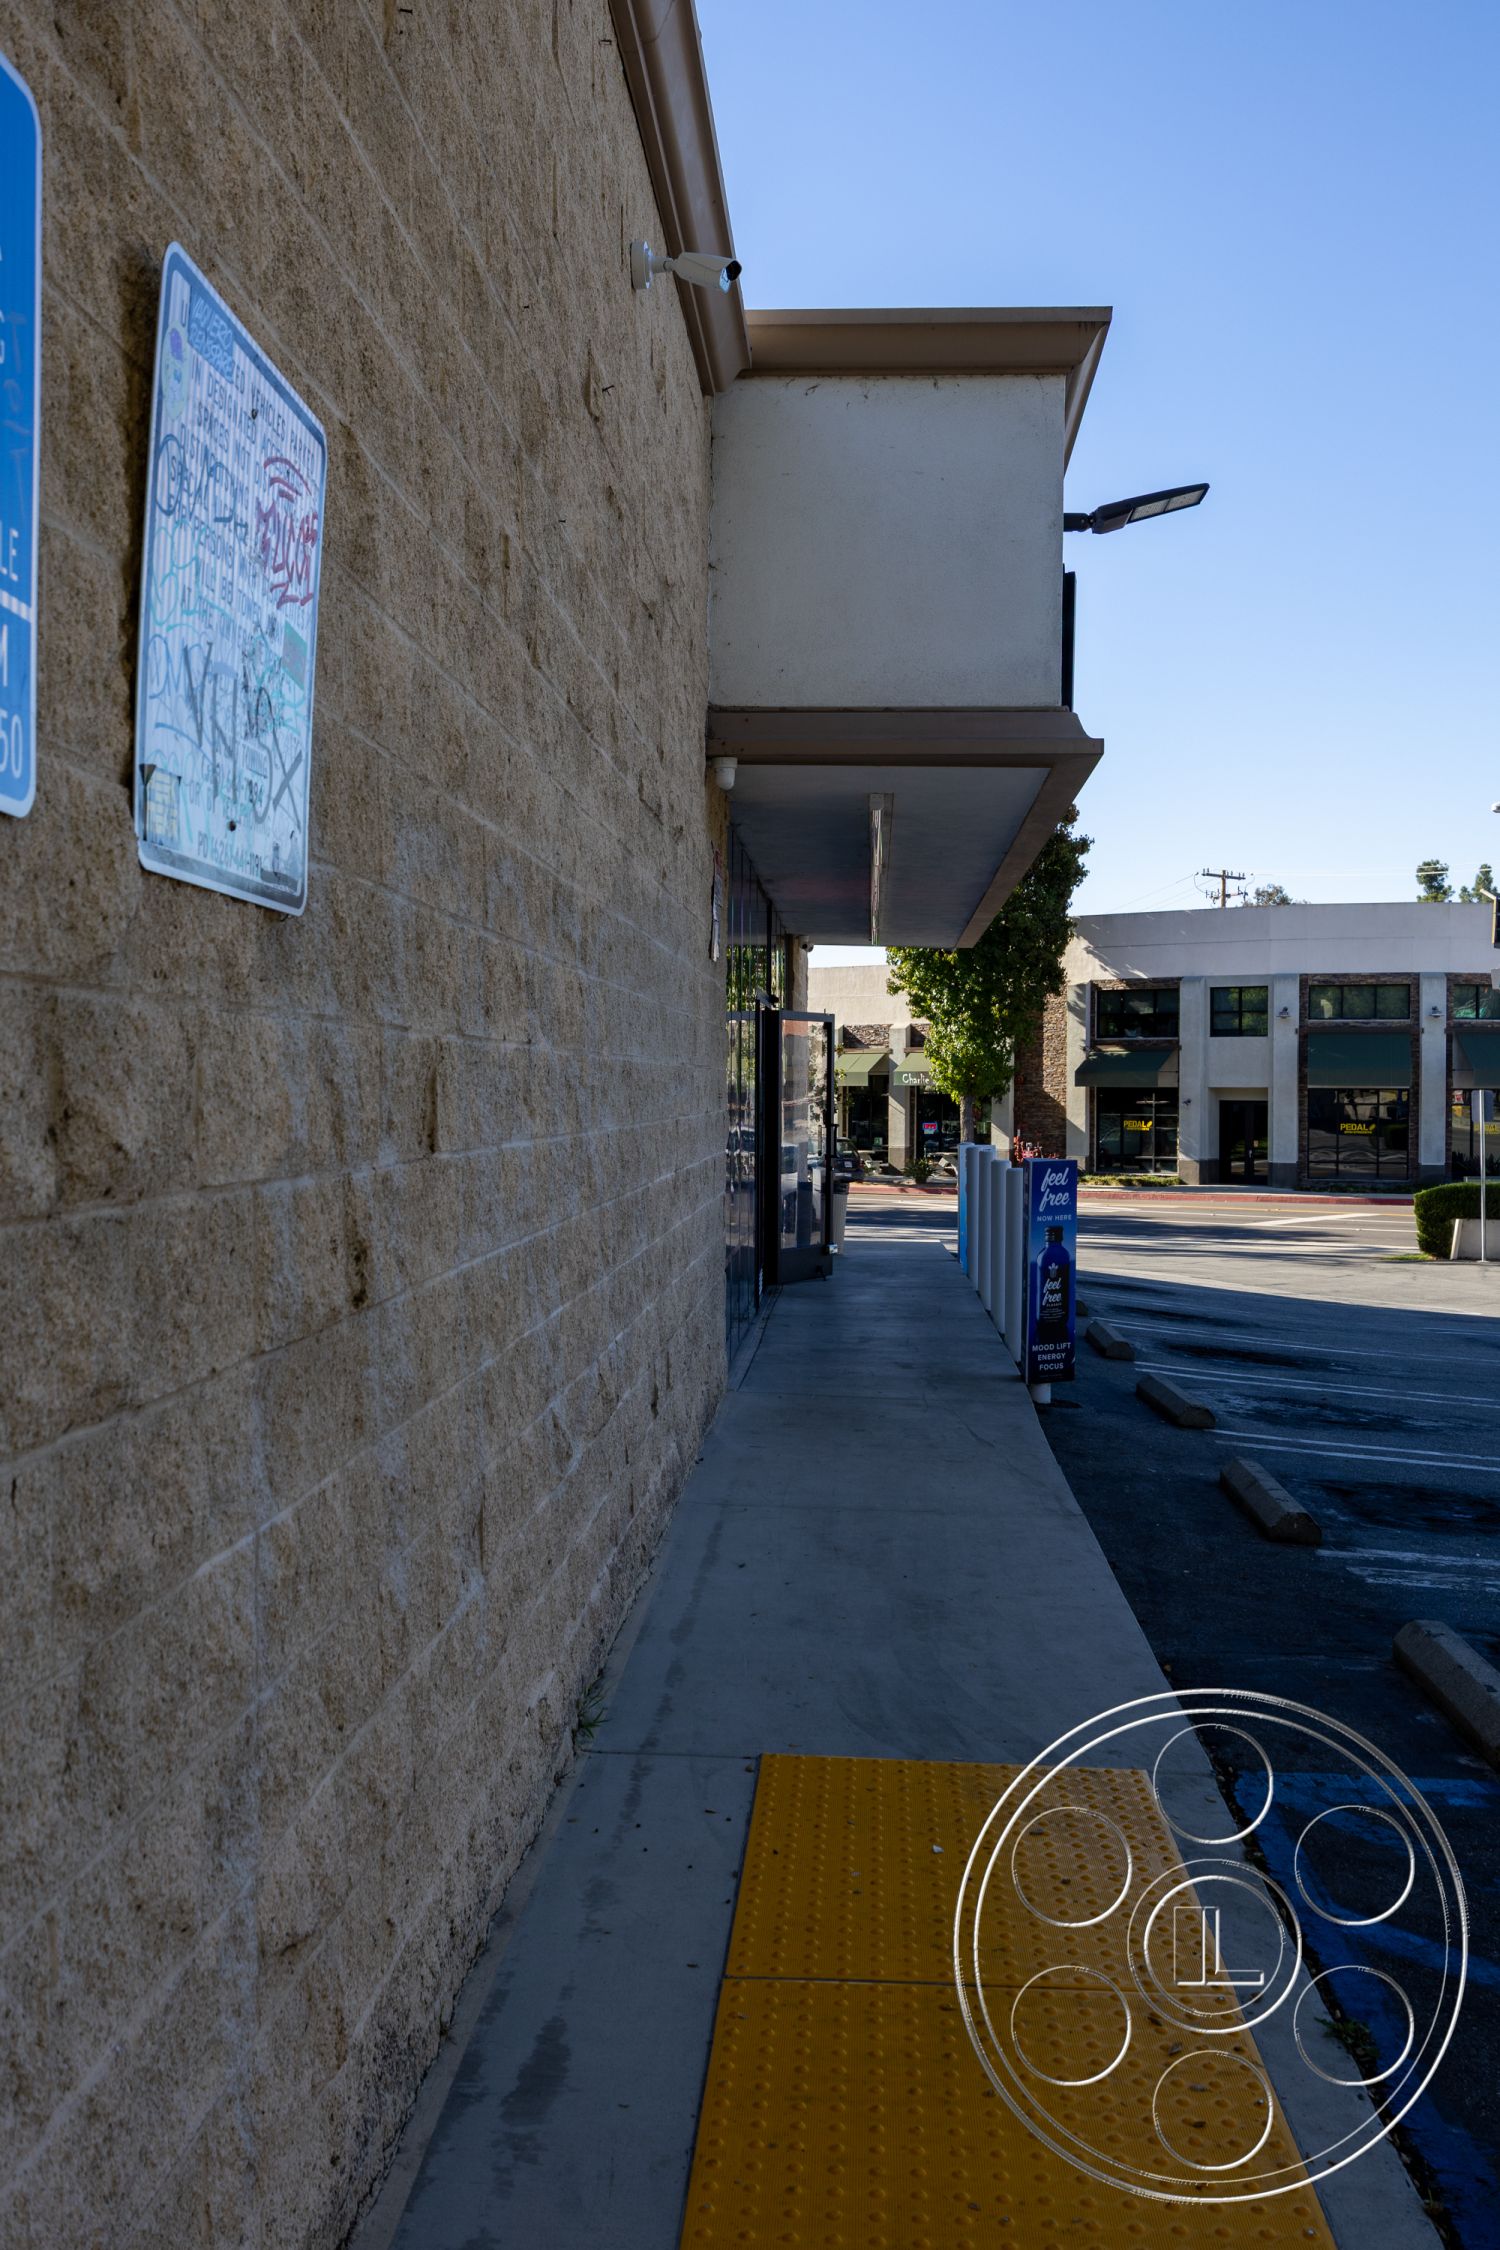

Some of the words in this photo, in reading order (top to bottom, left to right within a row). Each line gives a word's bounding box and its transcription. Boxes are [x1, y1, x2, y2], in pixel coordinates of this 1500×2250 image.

[191, 353, 202, 387] IN
[207, 373, 257, 443] DESIGNATED
[197, 401, 230, 453] SPACES
[234, 439, 251, 475] NOT
[250, 383, 286, 442] VEHICLES
[290, 429, 315, 476] PARKED
[193, 515, 233, 569] PERSONS
[239, 554, 257, 589] WITH
[180, 583, 192, 613] AT
[197, 595, 215, 629] THE
[237, 588, 261, 628] TOWED
[189, 779, 201, 807] OR
[1123, 1120, 1147, 1128] PEDAL
[1339, 1123, 1369, 1131] PEDAL
[1040, 1167, 1069, 1192] feel
[1043, 1277, 1062, 1293] feel
[1042, 1290, 1063, 1306] free
[1032, 1343, 1055, 1352] MOOD
[1056, 1342, 1072, 1350] LIFT
[1037, 1352, 1066, 1361] ENERGY
[1039, 1362, 1064, 1371] FOCUS
